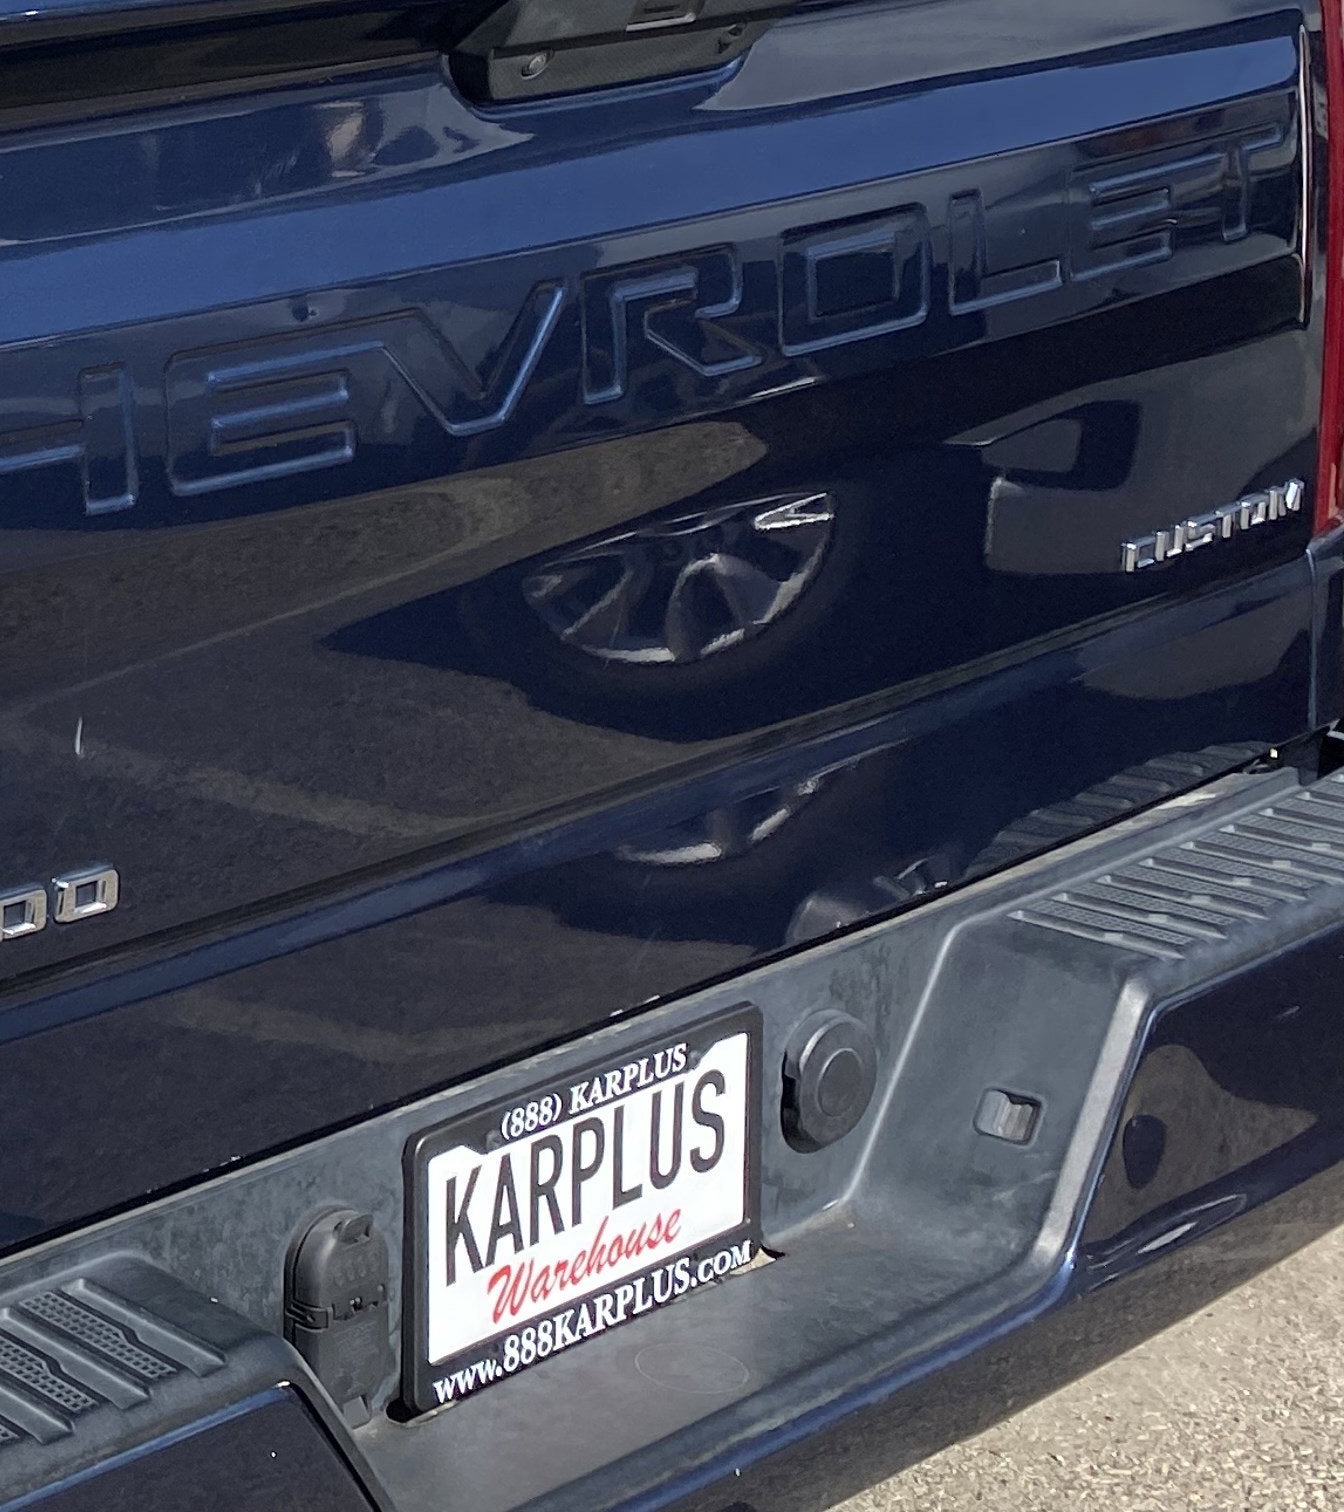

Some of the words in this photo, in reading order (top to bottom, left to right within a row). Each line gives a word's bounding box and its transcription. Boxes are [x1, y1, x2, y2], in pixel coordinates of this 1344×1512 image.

[1121, 478, 1305, 572] CUSTOM
[500, 1092, 562, 1142] (888)
[569, 1042, 688, 1116] KARPLUS
[444, 1068, 727, 1288] KARPLUS
[486, 1207, 683, 1325] Warehouse
